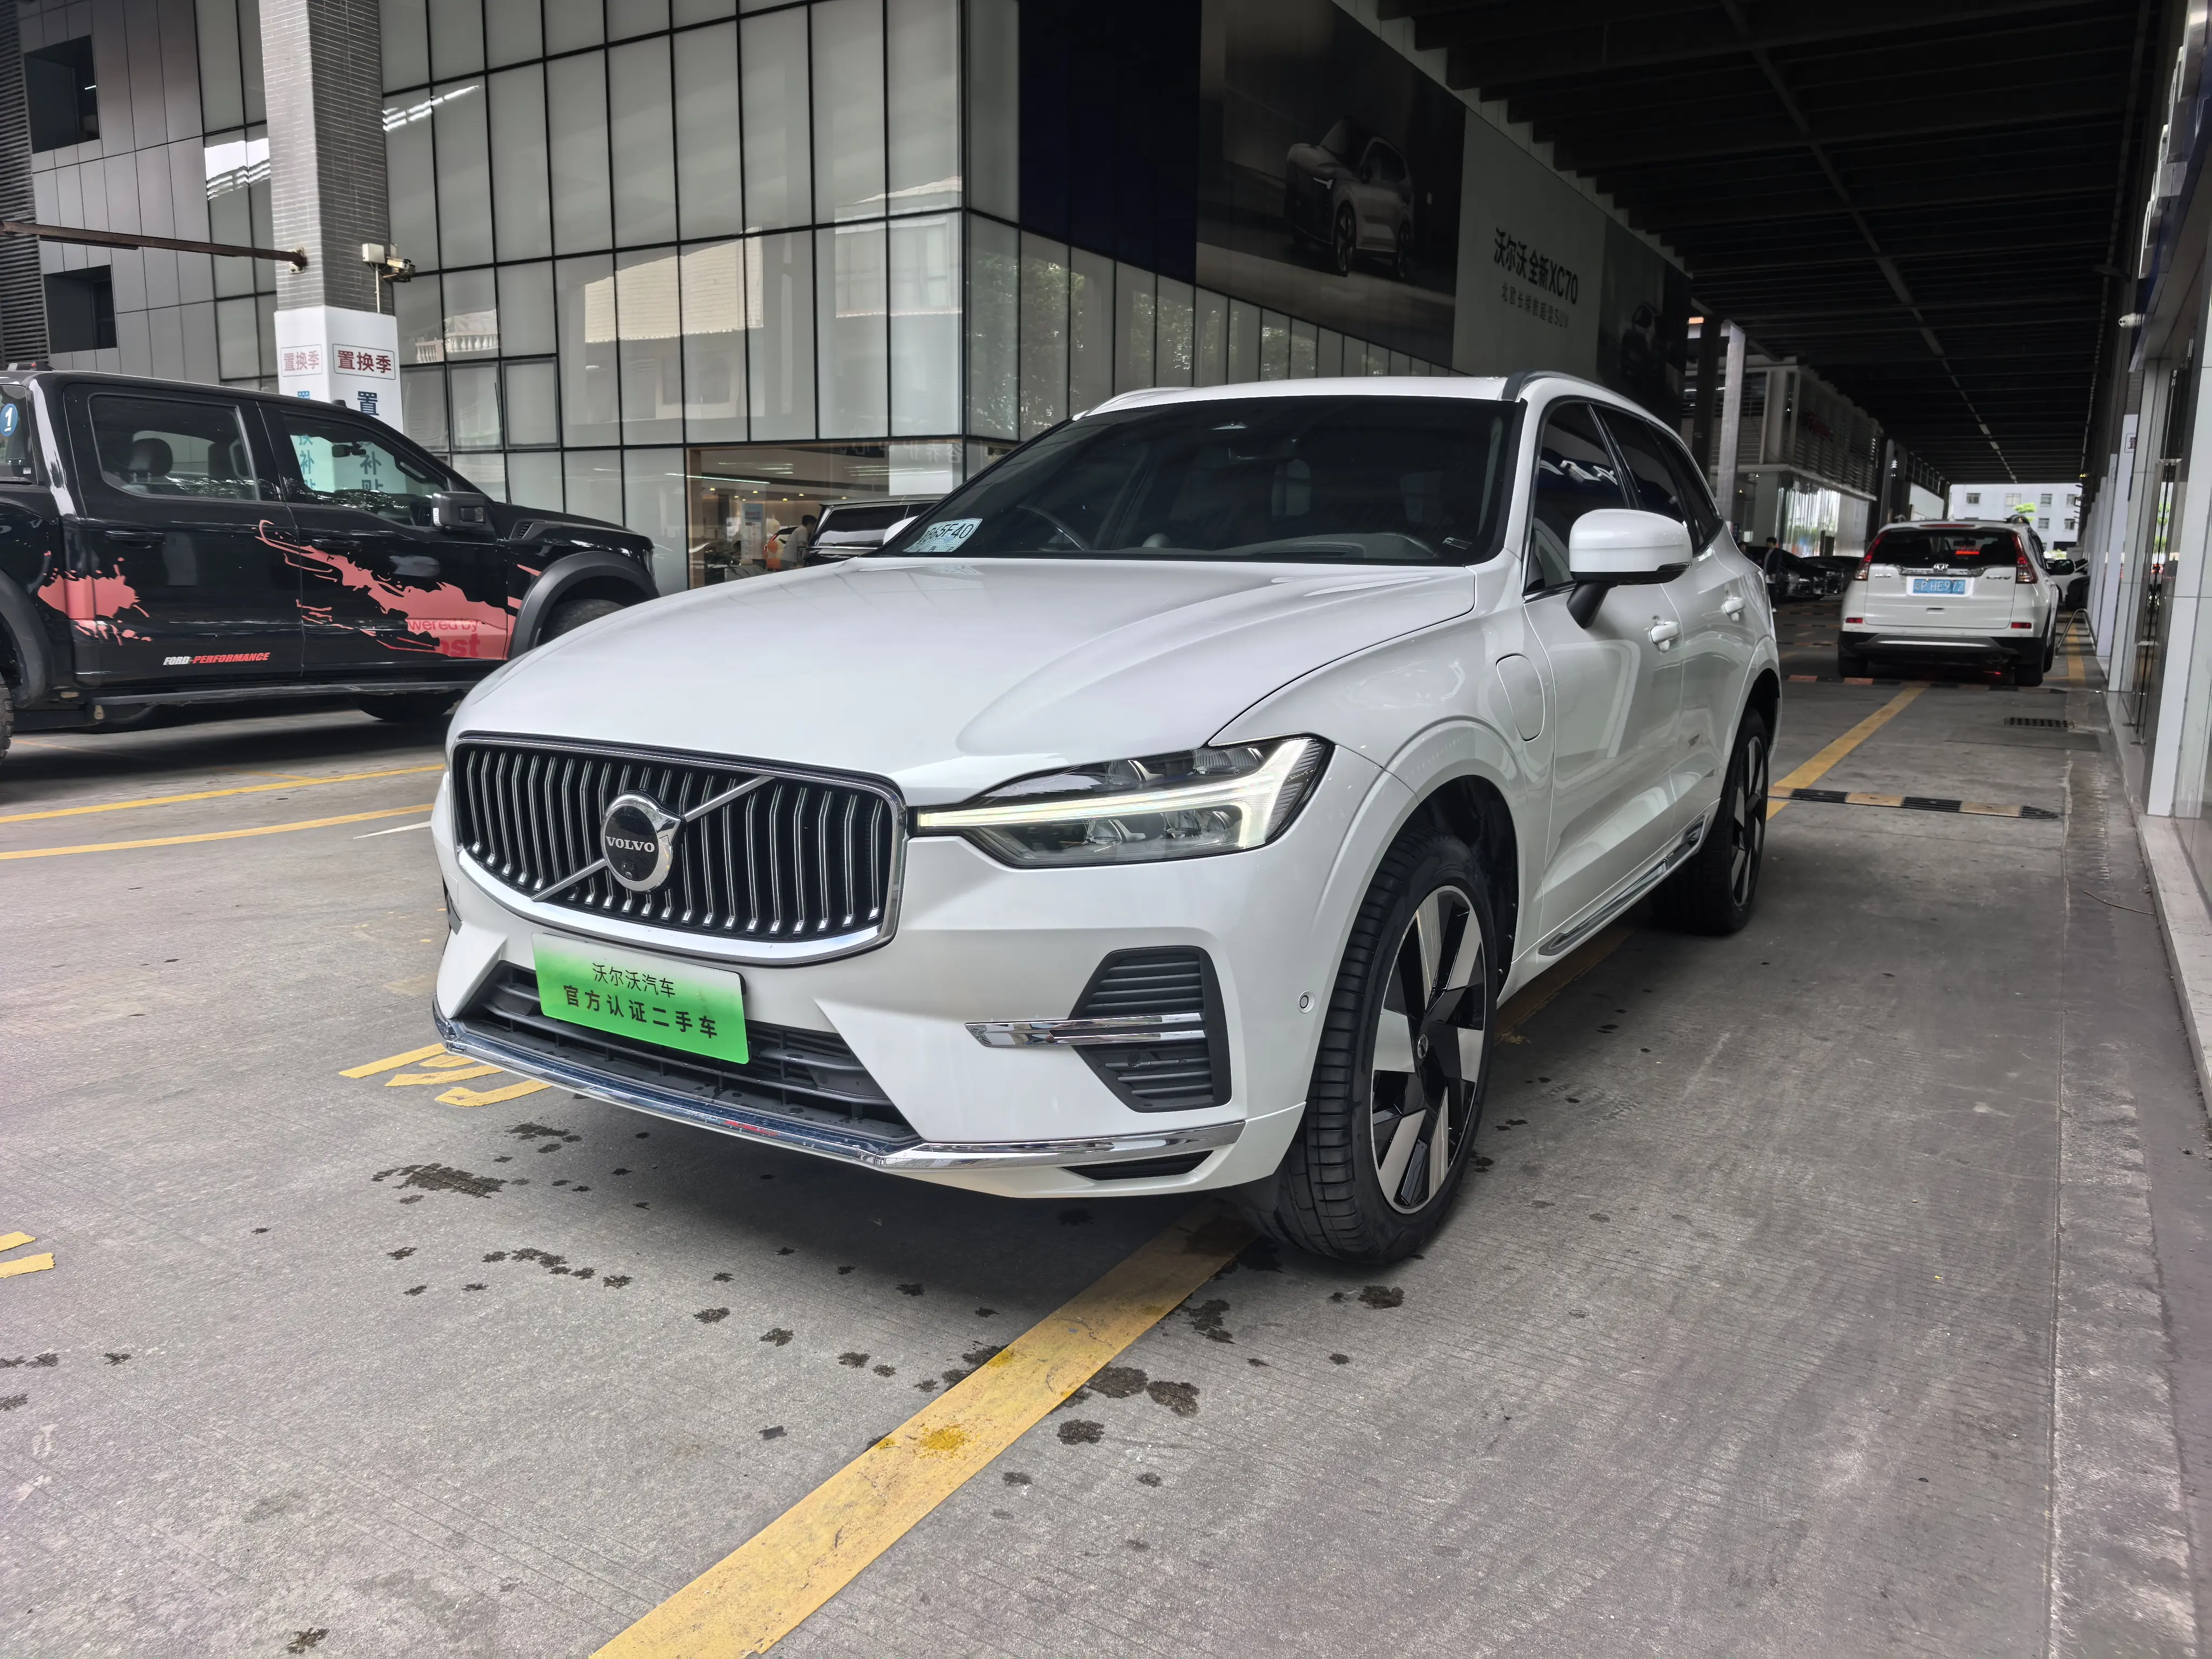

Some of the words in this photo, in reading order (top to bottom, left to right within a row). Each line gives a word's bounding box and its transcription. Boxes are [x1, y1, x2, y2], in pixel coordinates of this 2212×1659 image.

[284, 350, 320, 371] 置换季
[338, 350, 392, 374] 置换季
[605, 836, 655, 853] VOLVO
[592, 962, 676, 997] 沃尔沃汽车
[563, 984, 718, 1039] 官方认证二手车
